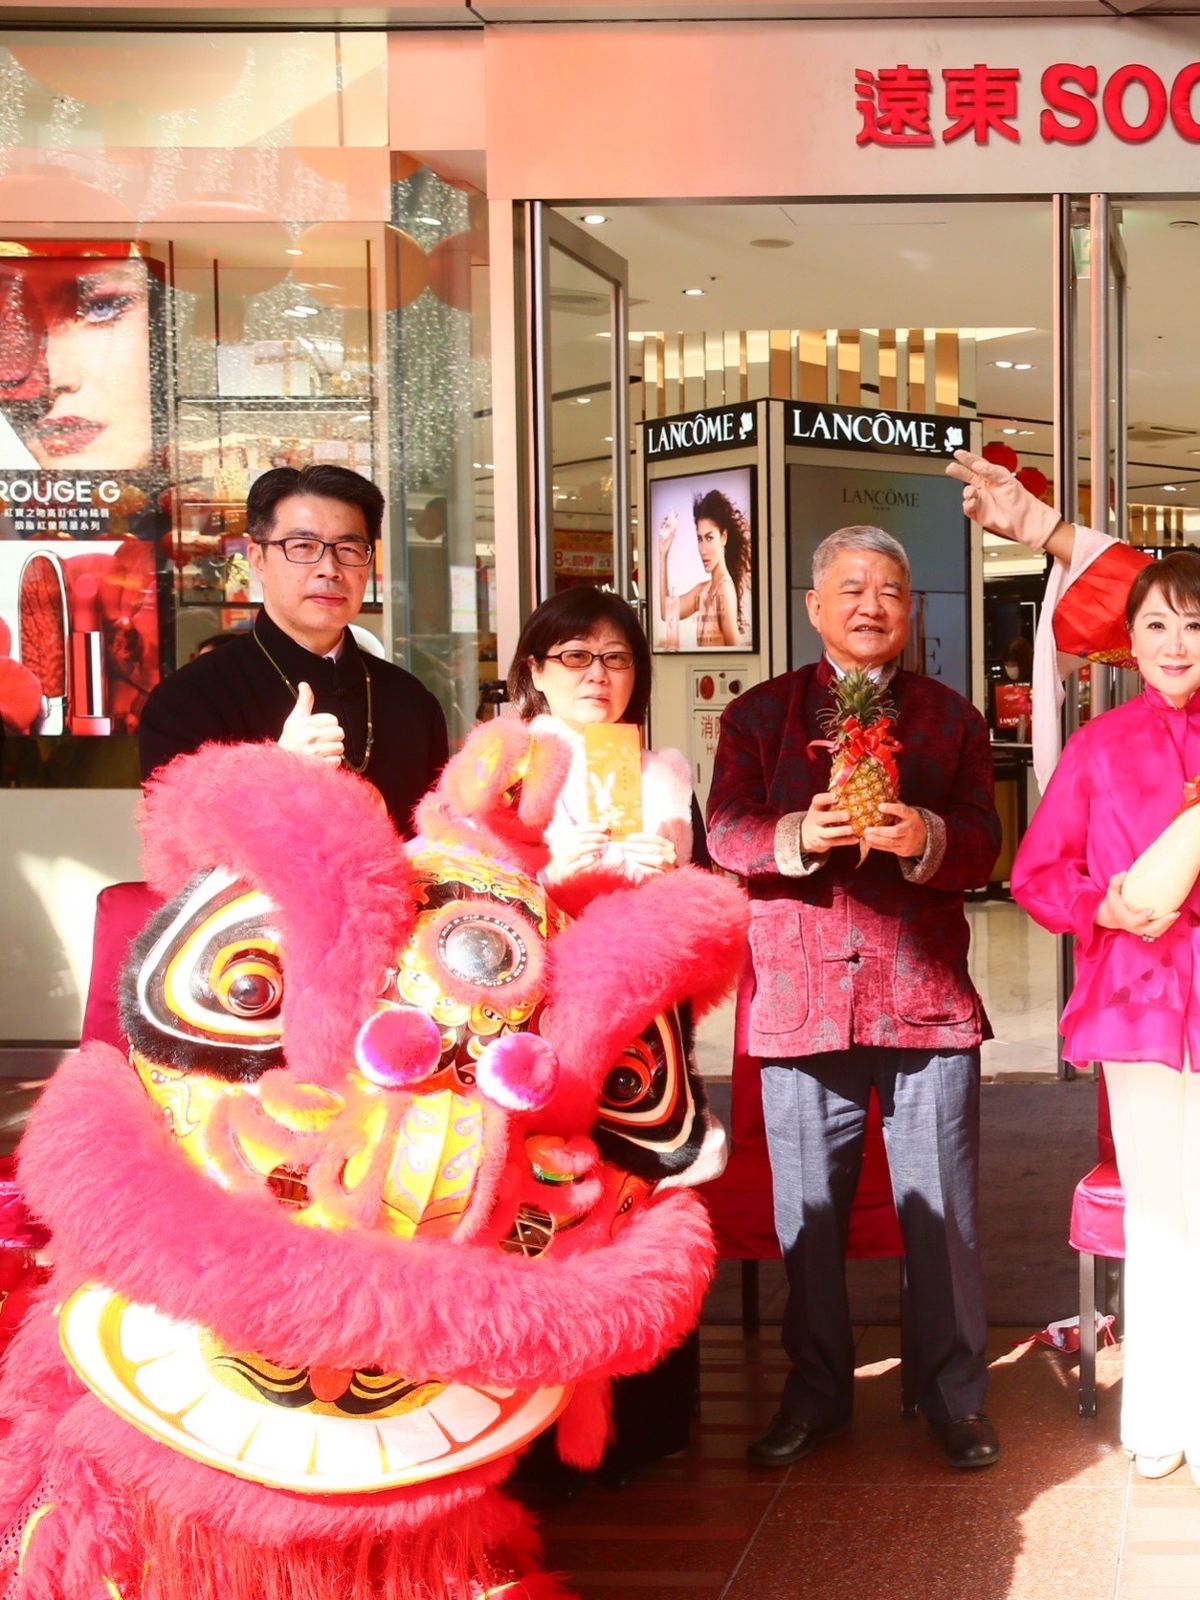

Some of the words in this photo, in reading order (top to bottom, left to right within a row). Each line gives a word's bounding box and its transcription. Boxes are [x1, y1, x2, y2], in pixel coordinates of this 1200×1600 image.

[855, 64, 1021, 148] 遠東
[648, 413, 735, 454] LANCÔME
[791, 409, 937, 449] LANCÔME
[99, 480, 120, 503] G
[842, 487, 920, 508] LANCÔME
